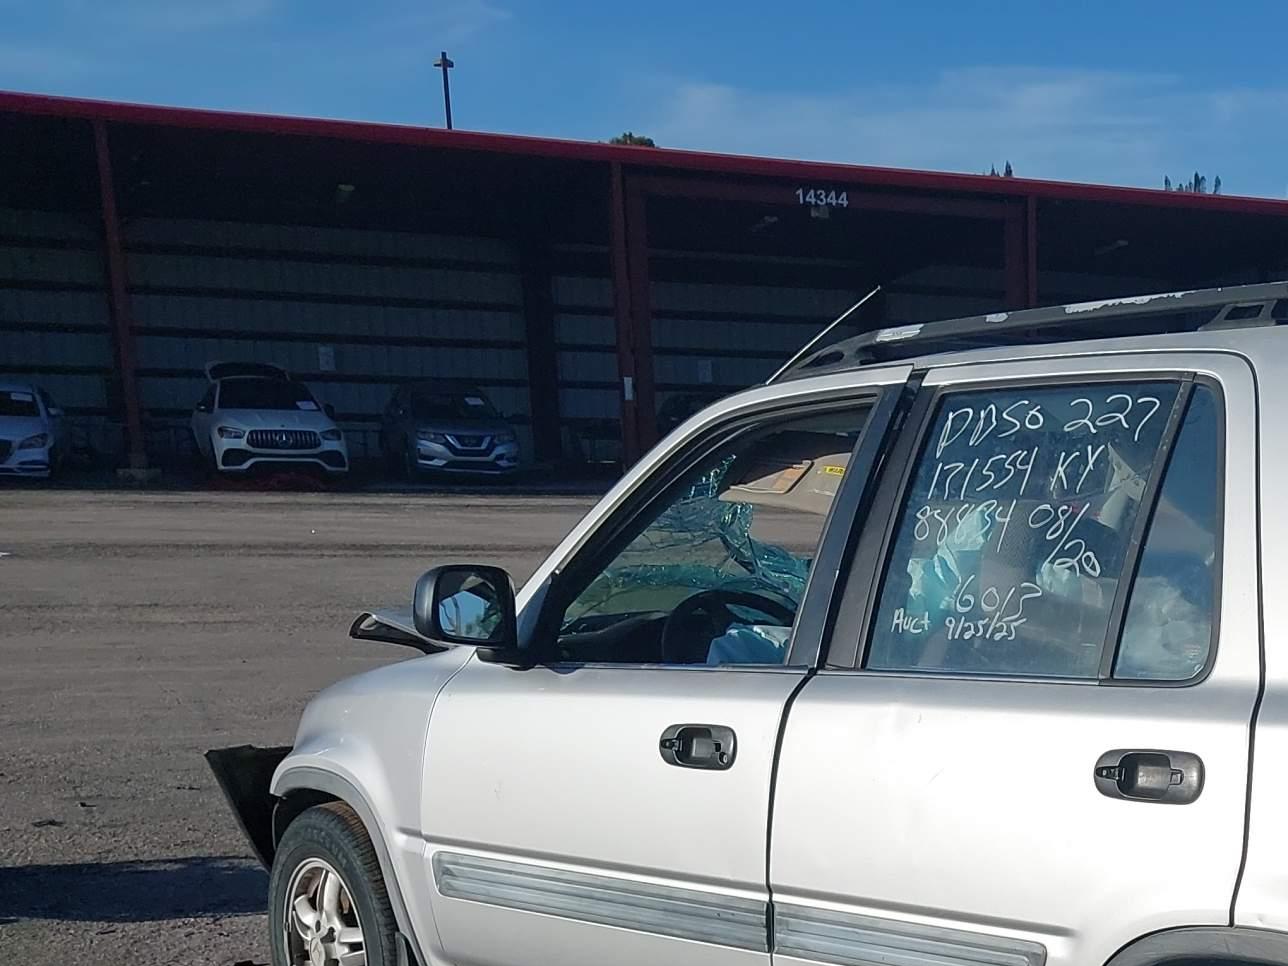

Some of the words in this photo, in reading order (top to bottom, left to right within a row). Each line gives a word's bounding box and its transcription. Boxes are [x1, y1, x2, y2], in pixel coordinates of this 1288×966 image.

[795, 187, 849, 208] 14344
[1063, 394, 1160, 442] 227
[927, 446, 1039, 501] 171554
[944, 612, 1027, 641] 9/25/25
